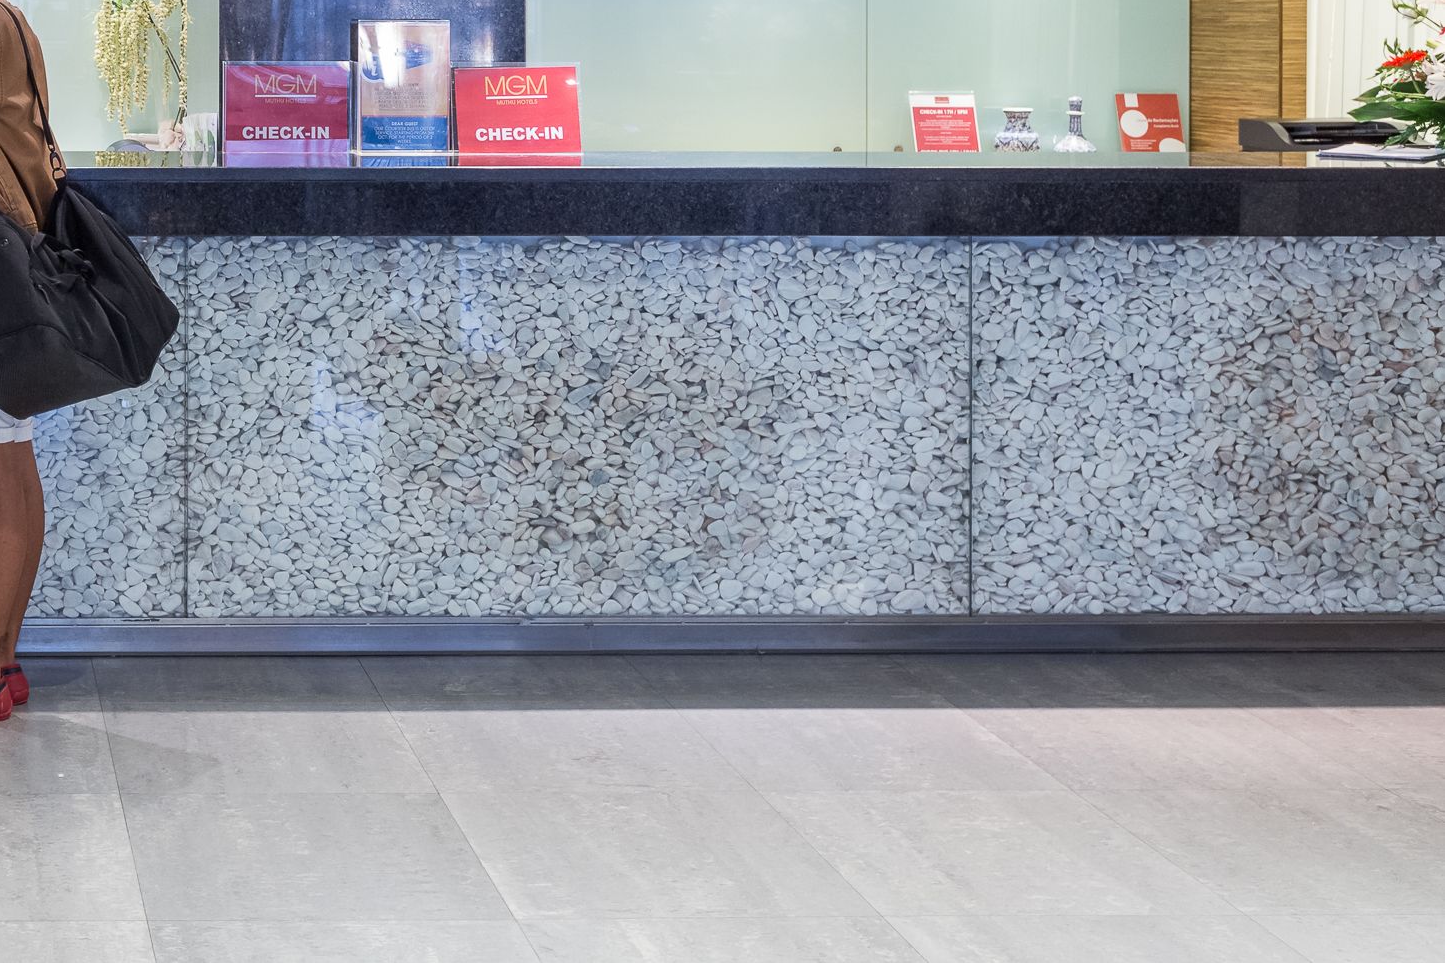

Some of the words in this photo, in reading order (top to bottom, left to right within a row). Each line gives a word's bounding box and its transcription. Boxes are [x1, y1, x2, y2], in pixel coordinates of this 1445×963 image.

[255, 74, 317, 94] MGM
[485, 75, 547, 95] MGM
[242, 126, 330, 139] CHECK-IN
[475, 126, 563, 141] CHECK-IN
